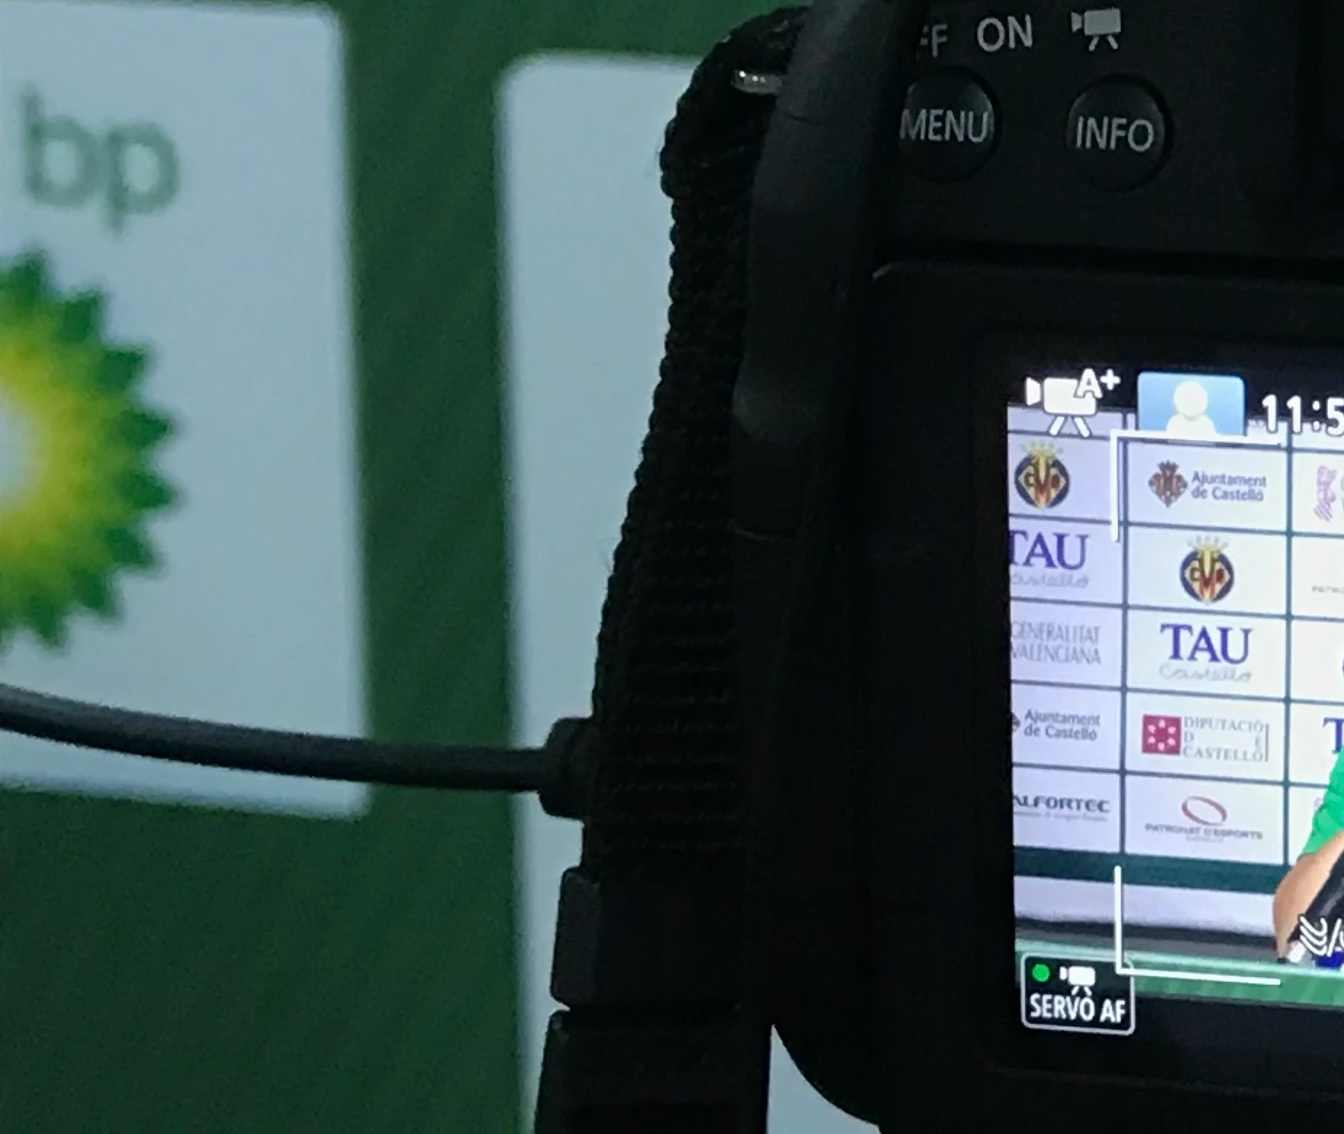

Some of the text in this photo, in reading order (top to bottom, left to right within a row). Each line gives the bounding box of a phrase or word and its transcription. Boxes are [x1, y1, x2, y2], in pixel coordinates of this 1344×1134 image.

[977, 13, 1033, 53] ON
[901, 107, 990, 144] MENU
[1074, 115, 1155, 153] INFO
[20, 82, 183, 234] bp
[1191, 470, 1267, 490] Ajuntament
[1191, 484, 1208, 500] de
[1159, 623, 1253, 665] TAU
[1023, 708, 1101, 727] Ajuntament
[1030, 992, 1126, 1024] SERVO AF
